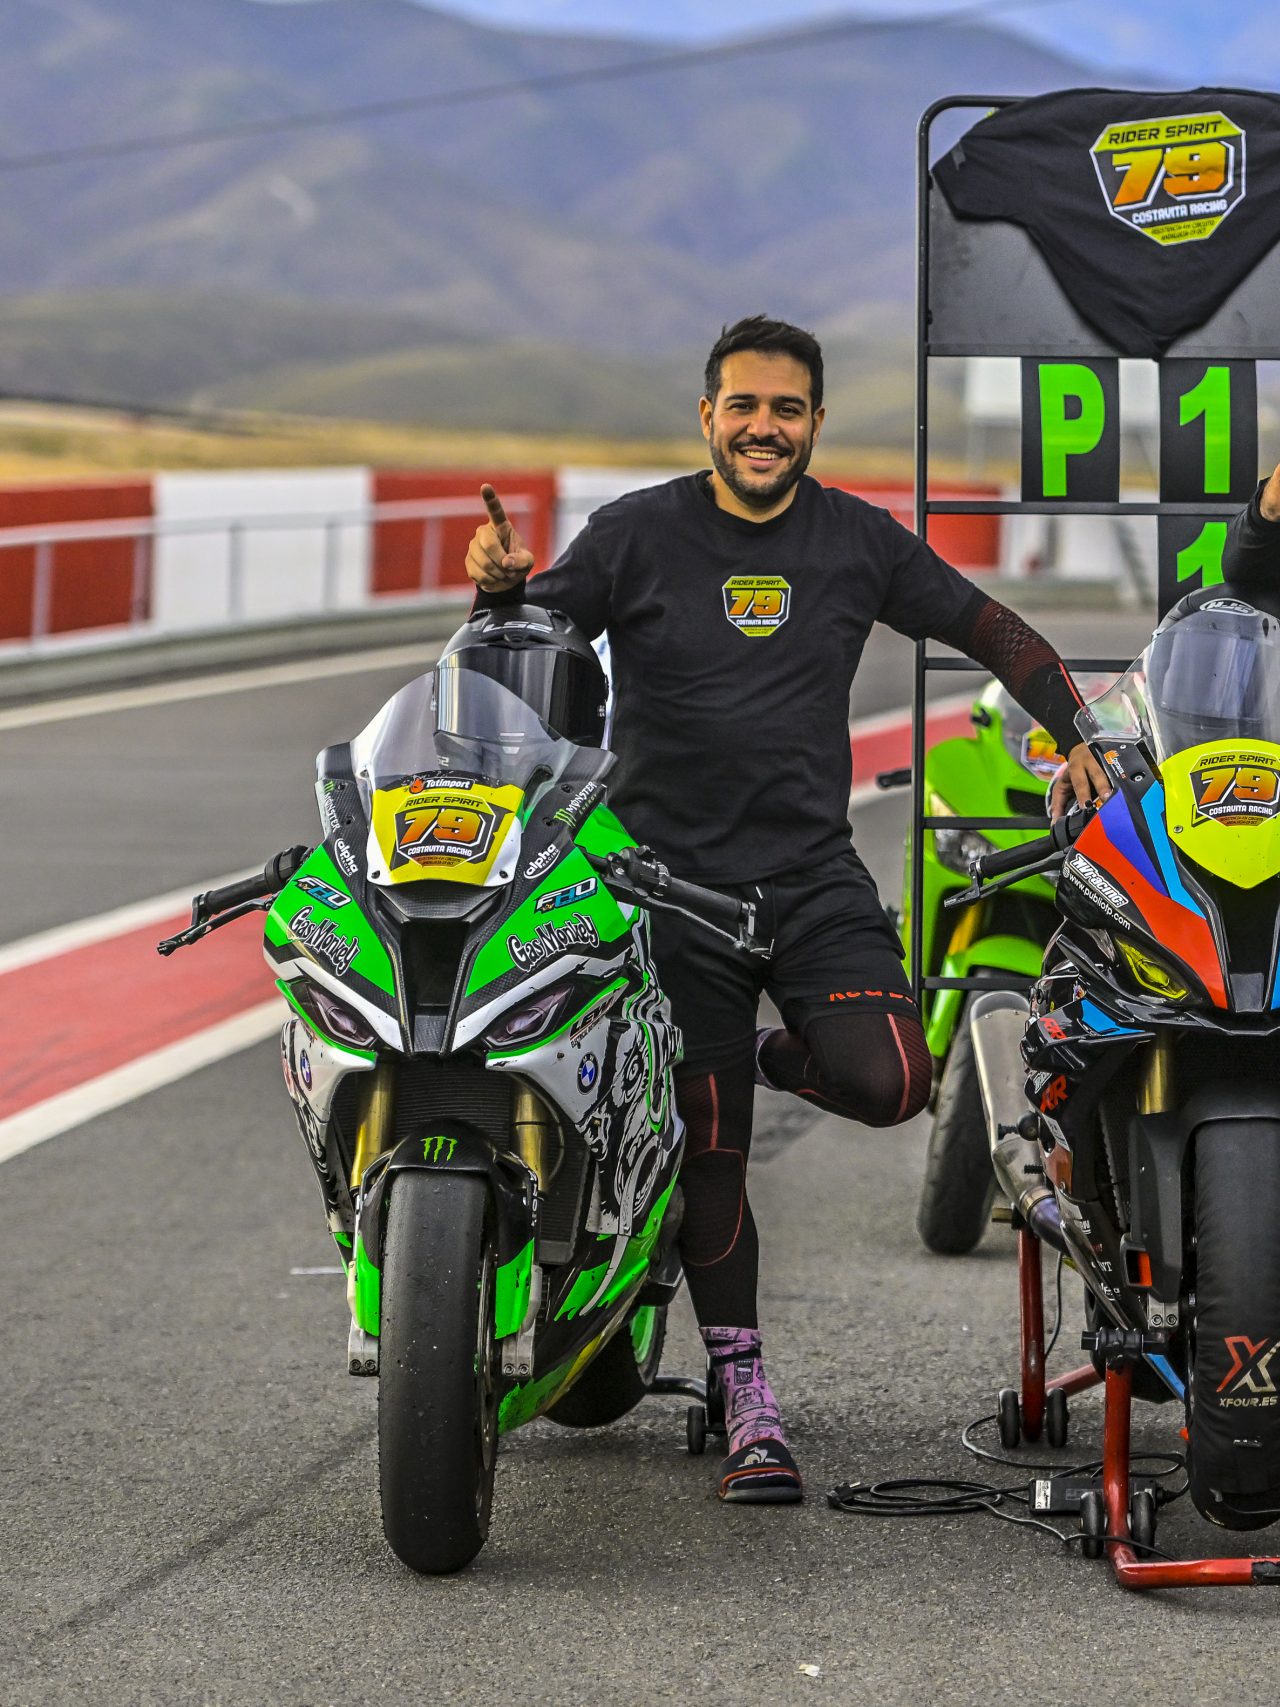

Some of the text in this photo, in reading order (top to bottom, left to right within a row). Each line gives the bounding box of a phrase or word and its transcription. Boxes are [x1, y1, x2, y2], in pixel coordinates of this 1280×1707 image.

[1108, 120, 1222, 145] RIDER SPIRIT
[1112, 141, 1235, 212] 79
[1038, 364, 1230, 496] P 1
[728, 590, 785, 617] 79
[482, 620, 553, 634] LS2
[1200, 754, 1277, 767] RIDER SPIRIT
[405, 796, 483, 808] RIDER SPIRIT
[566, 781, 598, 813] MONSTER
[1199, 767, 1280, 809] 79
[399, 808, 486, 849] 79
[338, 841, 359, 873] alpha
[526, 843, 557, 876] alpha
[1219, 1396, 1278, 1407] XFOUR.ES
